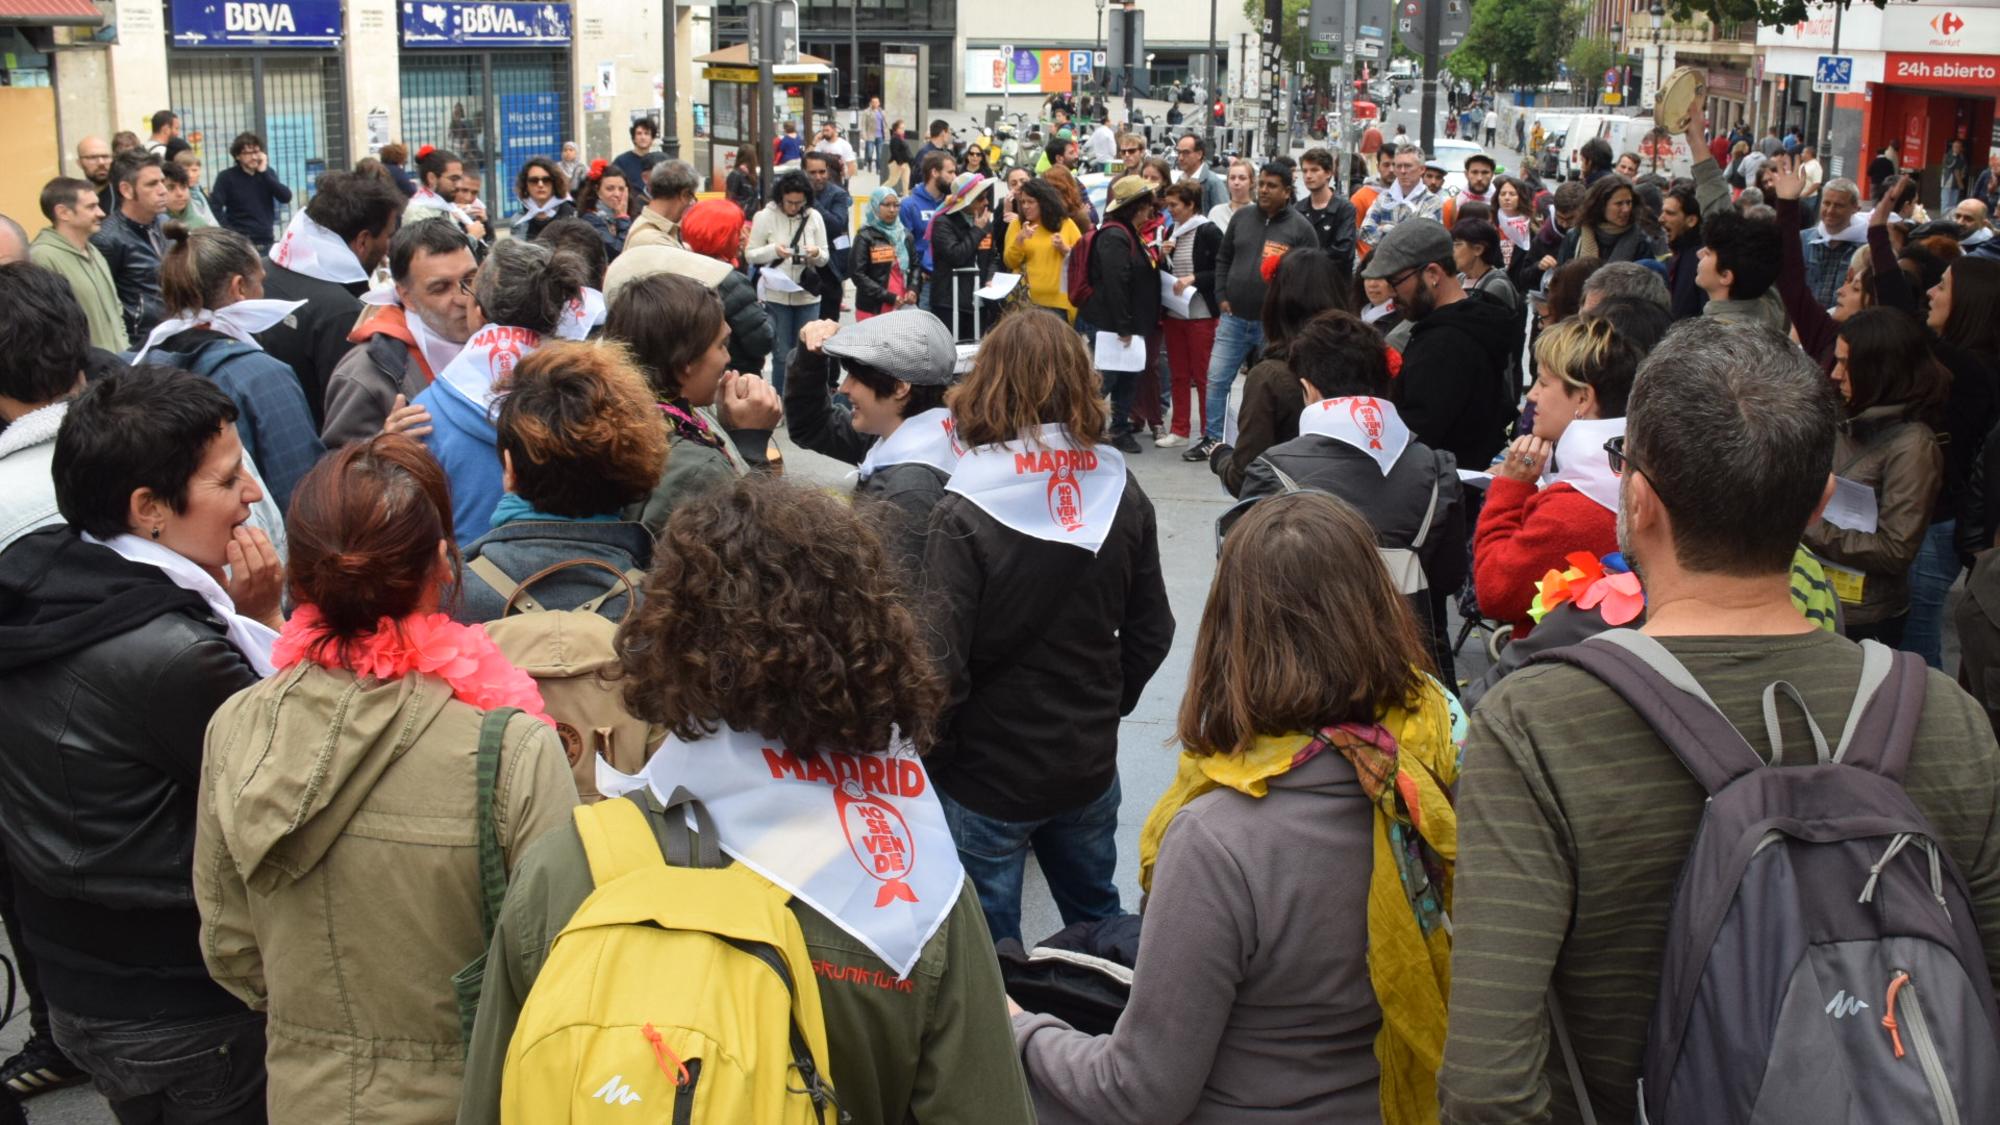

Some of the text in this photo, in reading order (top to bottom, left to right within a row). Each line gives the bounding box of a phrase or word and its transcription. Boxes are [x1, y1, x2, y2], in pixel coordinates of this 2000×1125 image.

[224, 2, 296, 32] BBVA
[462, 7, 518, 33] BBVA
[1929, 38, 1961, 47] market
[1073, 53, 1088, 72] P
[1898, 61, 1996, 79] 24h abierto
[1368, 428, 1379, 437] DE
[1015, 450, 1097, 474] MADRID
[1058, 485, 1072, 496] NO
[1060, 495, 1073, 506] SE
[1056, 505, 1077, 517] VEN
[1060, 516, 1075, 526] DE
[762, 747, 926, 798] MADRID
[856, 804, 885, 820] NO
[865, 818, 893, 835] SE
[862, 834, 906, 854] VEN
[873, 852, 905, 874] DE
